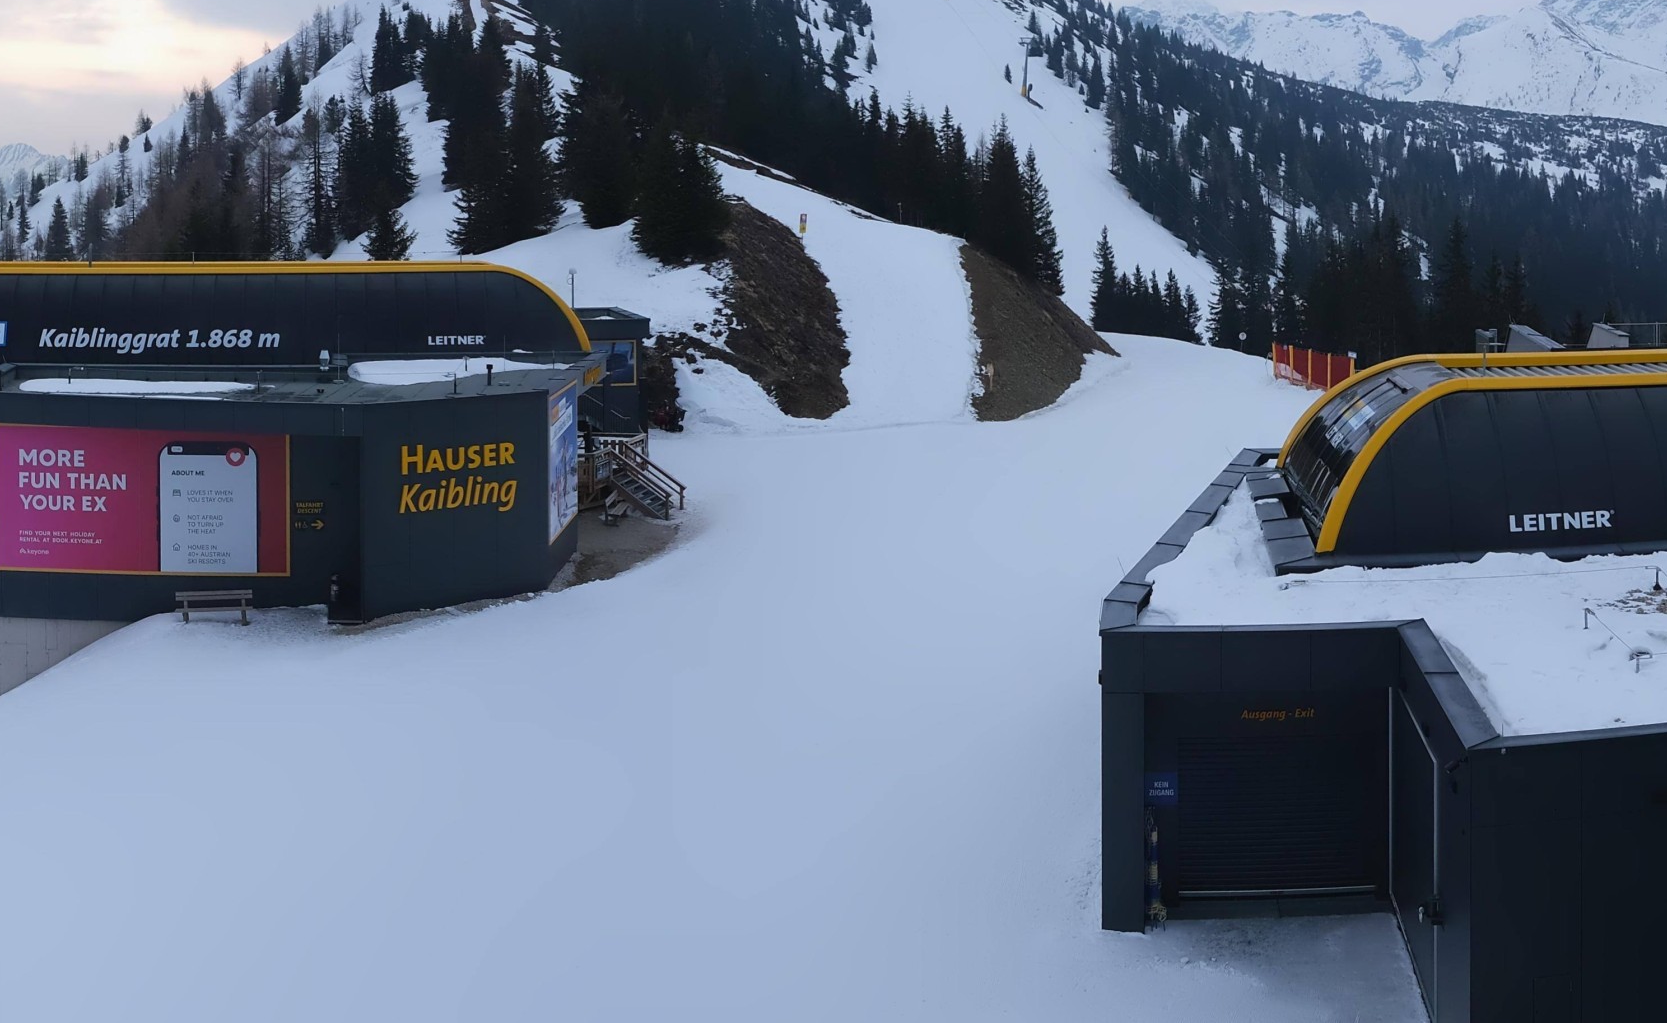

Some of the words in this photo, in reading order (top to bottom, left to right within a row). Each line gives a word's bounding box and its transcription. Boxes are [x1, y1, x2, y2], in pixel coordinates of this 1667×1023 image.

[39, 327, 181, 354] Kaiblinggrat
[186, 329, 253, 348] 1.868
[258, 332, 281, 348] m
[18, 448, 85, 468] MORE
[401, 442, 516, 475] HAUSER
[18, 471, 60, 489] FUN
[66, 472, 127, 490] THAN
[20, 494, 75, 511] YOUR
[82, 496, 107, 512] EX
[399, 476, 518, 514] Kaibling
[1241, 709, 1286, 721] Ausgang
[1295, 708, 1315, 718] Exit
